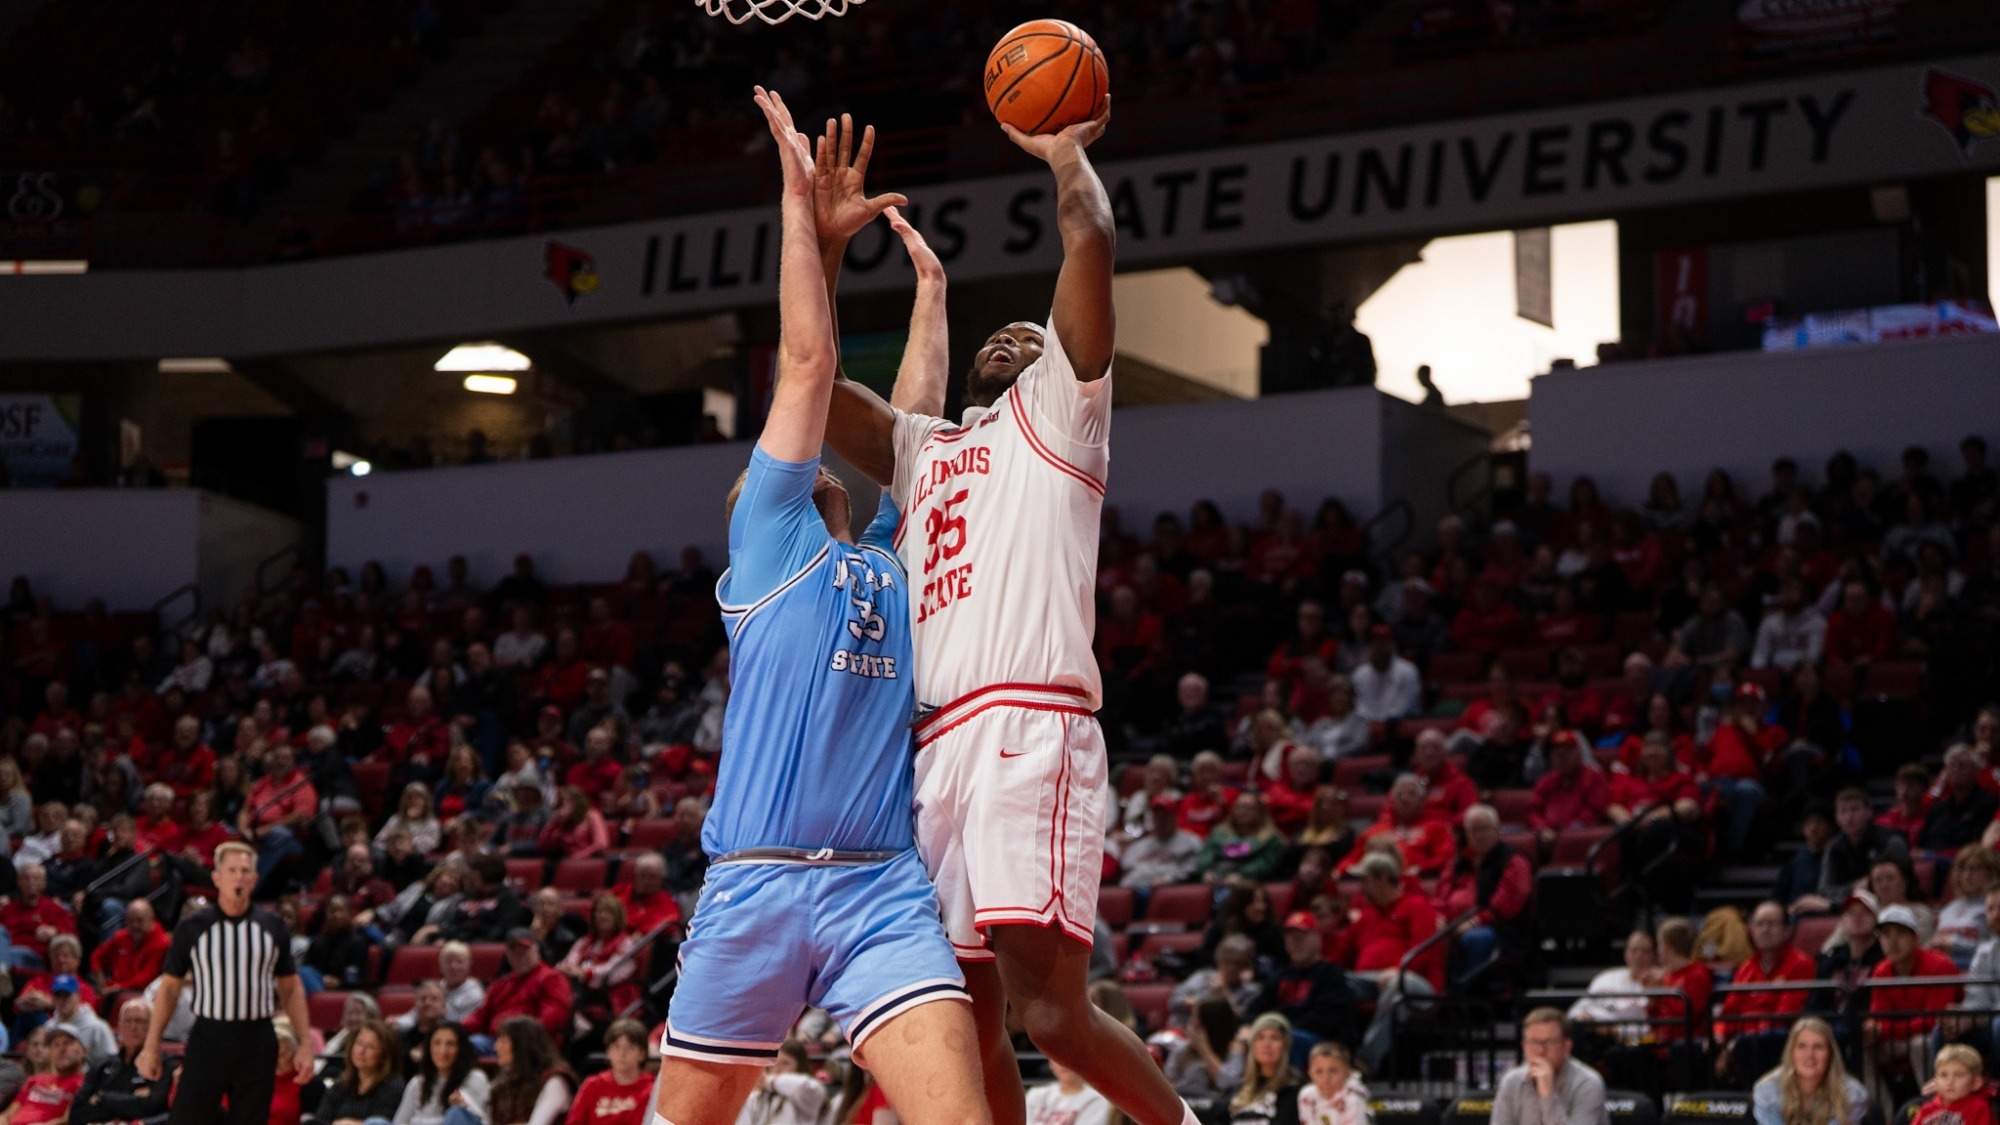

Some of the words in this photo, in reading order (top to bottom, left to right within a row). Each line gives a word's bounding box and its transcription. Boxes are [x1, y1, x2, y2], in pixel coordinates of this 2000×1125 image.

[984, 44, 1028, 94] ELITE
[640, 197, 970, 296] ILLIOIS
[1002, 163, 1248, 256] SATE
[1287, 89, 1856, 223] UNIVERSITY
[924, 489, 969, 575] 35
[831, 648, 897, 679] STATE
